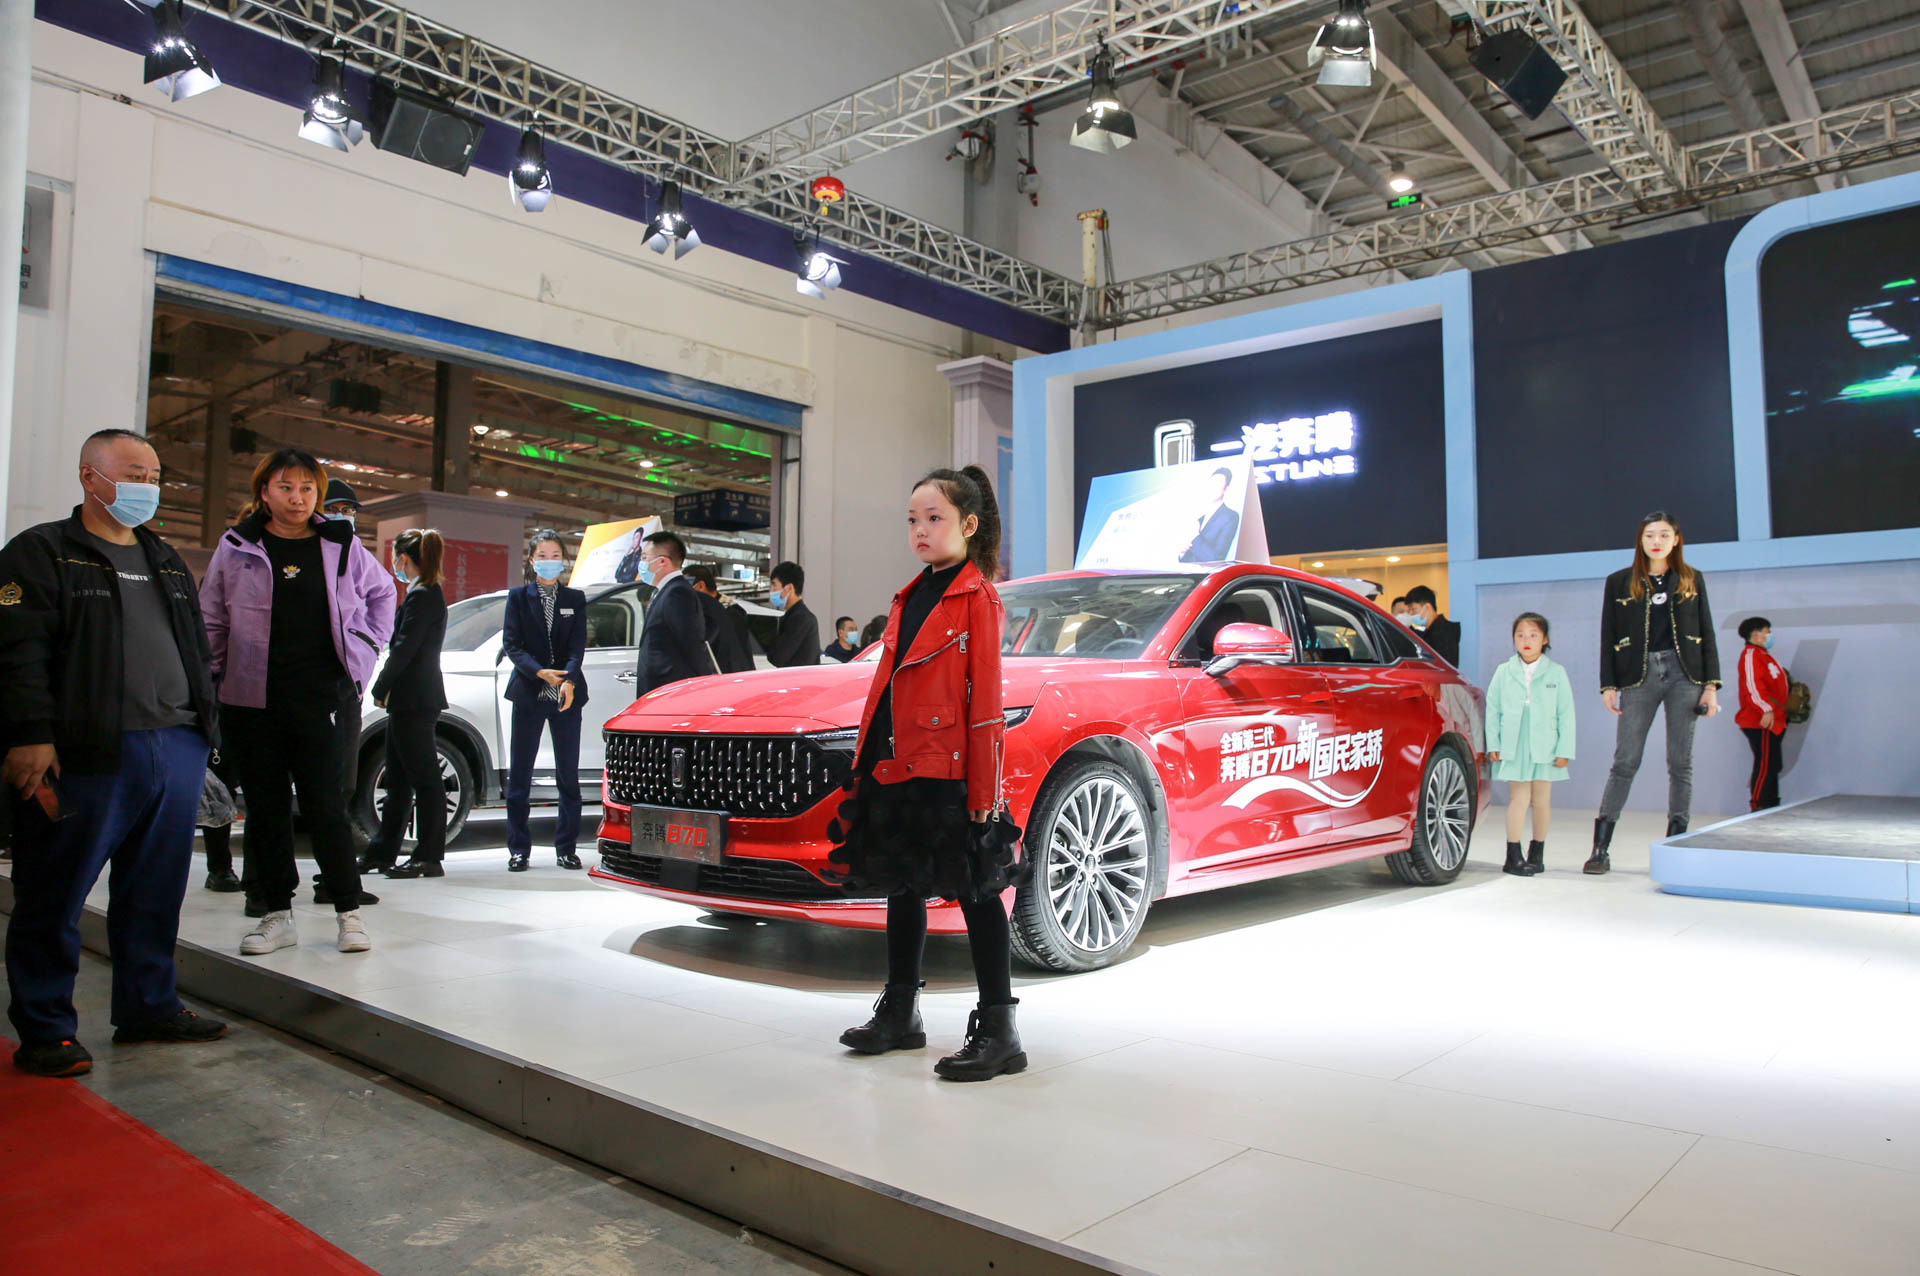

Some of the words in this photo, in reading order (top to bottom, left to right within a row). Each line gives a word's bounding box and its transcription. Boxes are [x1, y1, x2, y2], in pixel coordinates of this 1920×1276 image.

[1253, 455, 1355, 484] STUNE
[1219, 725, 1275, 755] 全新第三代
[1296, 720, 1383, 780] 新国民家轿
[1220, 743, 1296, 783] 奔腾B70
